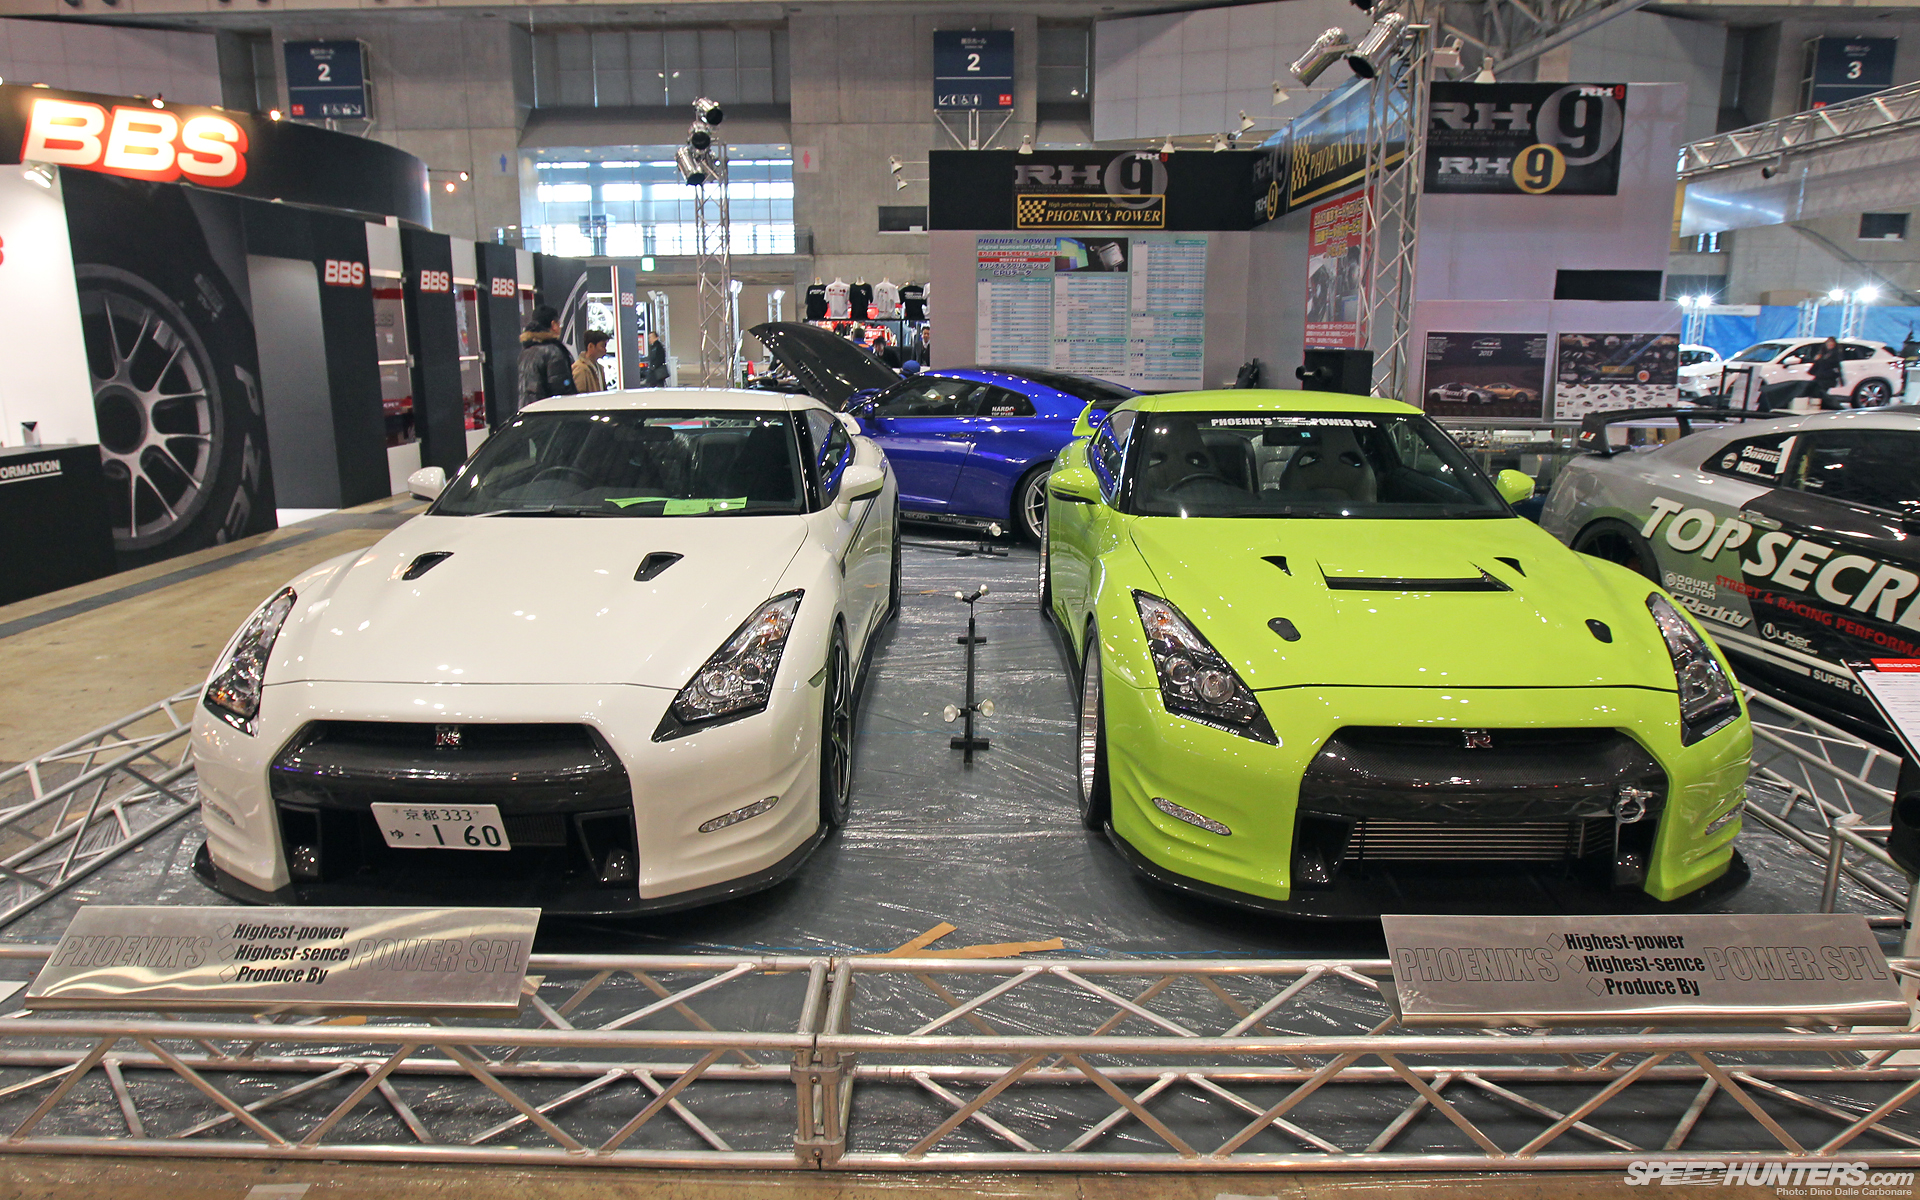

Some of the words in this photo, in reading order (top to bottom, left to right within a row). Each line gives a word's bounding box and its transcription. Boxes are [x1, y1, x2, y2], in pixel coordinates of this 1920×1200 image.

[967, 54, 980, 71] 2
[1847, 61, 1862, 79] 3
[317, 63, 332, 82] 2
[1579, 85, 1625, 99] RH9
[21, 97, 247, 186] BBS
[1045, 209, 1111, 222] PHOENIX's
[1114, 209, 1160, 222] POWER
[325, 259, 364, 286] BBS
[420, 270, 449, 293] BBS
[491, 277, 515, 297] BBS
[1211, 417, 1273, 427] PHOENIX'S
[1312, 418, 1354, 427] POWER
[1353, 419, 1377, 428] SPL
[1775, 435, 1797, 474] 1
[1641, 496, 1753, 561] TOP
[1675, 582, 1716, 600] CLUTCH
[1676, 574, 1716, 592] OGURA
[1716, 575, 1762, 599] STREET
[1764, 593, 1774, 605] &
[1776, 597, 1832, 626] RACING
[1813, 670, 1851, 691] SUPER
[233, 923, 348, 941] Highest-power
[51, 935, 212, 968] PHOENIX'S
[1564, 933, 1685, 951] Highest-power
[234, 944, 349, 962] Highest-sence
[350, 937, 463, 971] POWER
[464, 938, 522, 974] SPL
[1396, 947, 1560, 982] PHOENIX'S
[1585, 955, 1705, 974] Highest-sence
[1704, 945, 1821, 982] POWER
[1822, 946, 1887, 982] SPL
[236, 966, 304, 982] Produce
[306, 966, 329, 985] By
[1605, 977, 1676, 996] Produce
[1677, 977, 1701, 998] By
